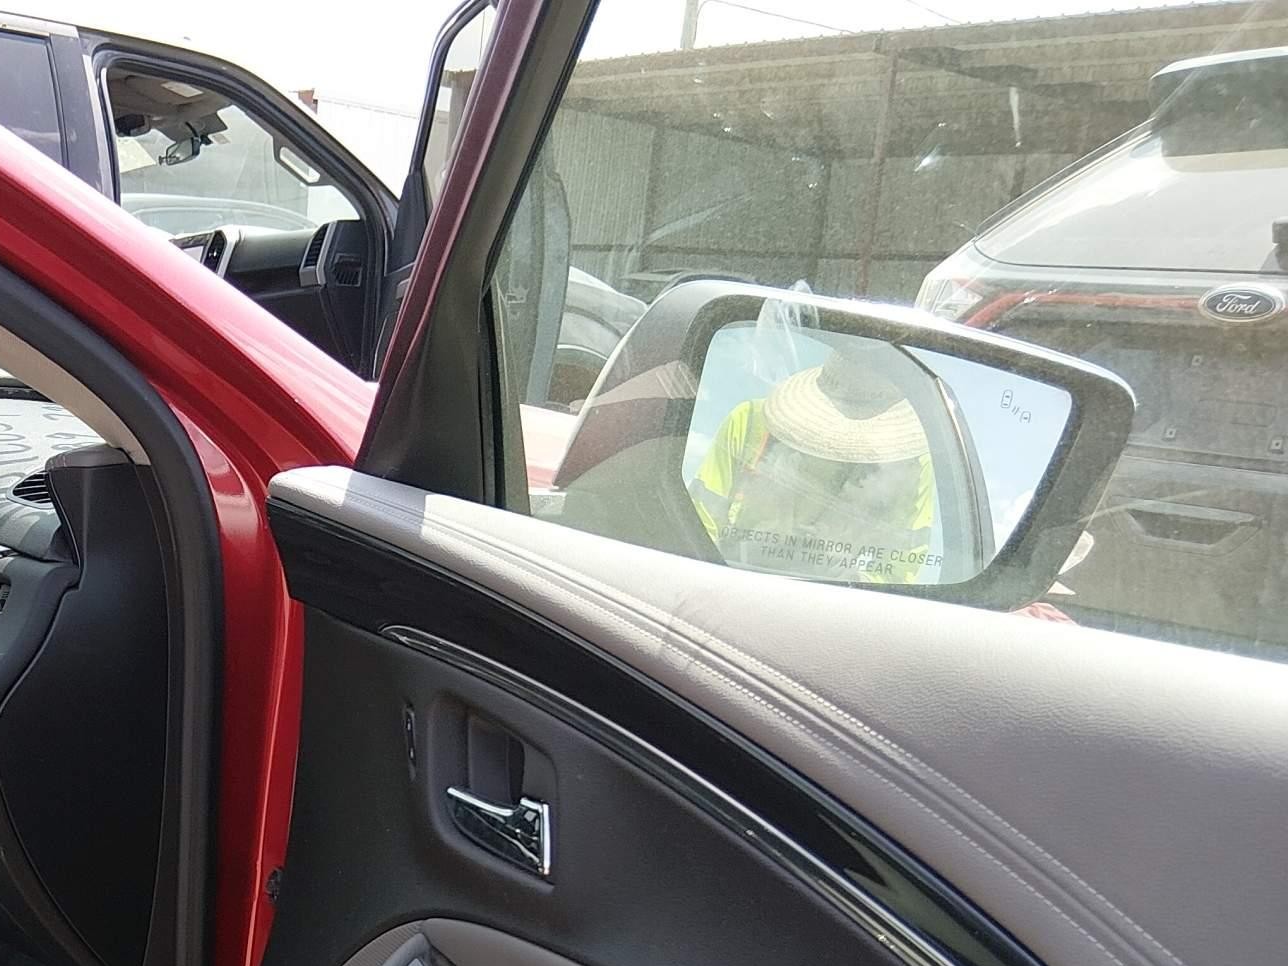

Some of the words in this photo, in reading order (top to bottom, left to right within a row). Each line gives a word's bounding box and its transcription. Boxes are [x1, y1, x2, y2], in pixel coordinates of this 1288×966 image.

[1215, 293, 1261, 314] Ford
[719, 525, 779, 544] OBJECTS
[784, 534, 798, 546] IN
[803, 536, 852, 555] MIRROR
[857, 546, 884, 560] ARE
[890, 550, 943, 568] CLOSER
[760, 545, 794, 561] THAN
[800, 552, 834, 568] THEY
[839, 558, 894, 575] APPEAR
